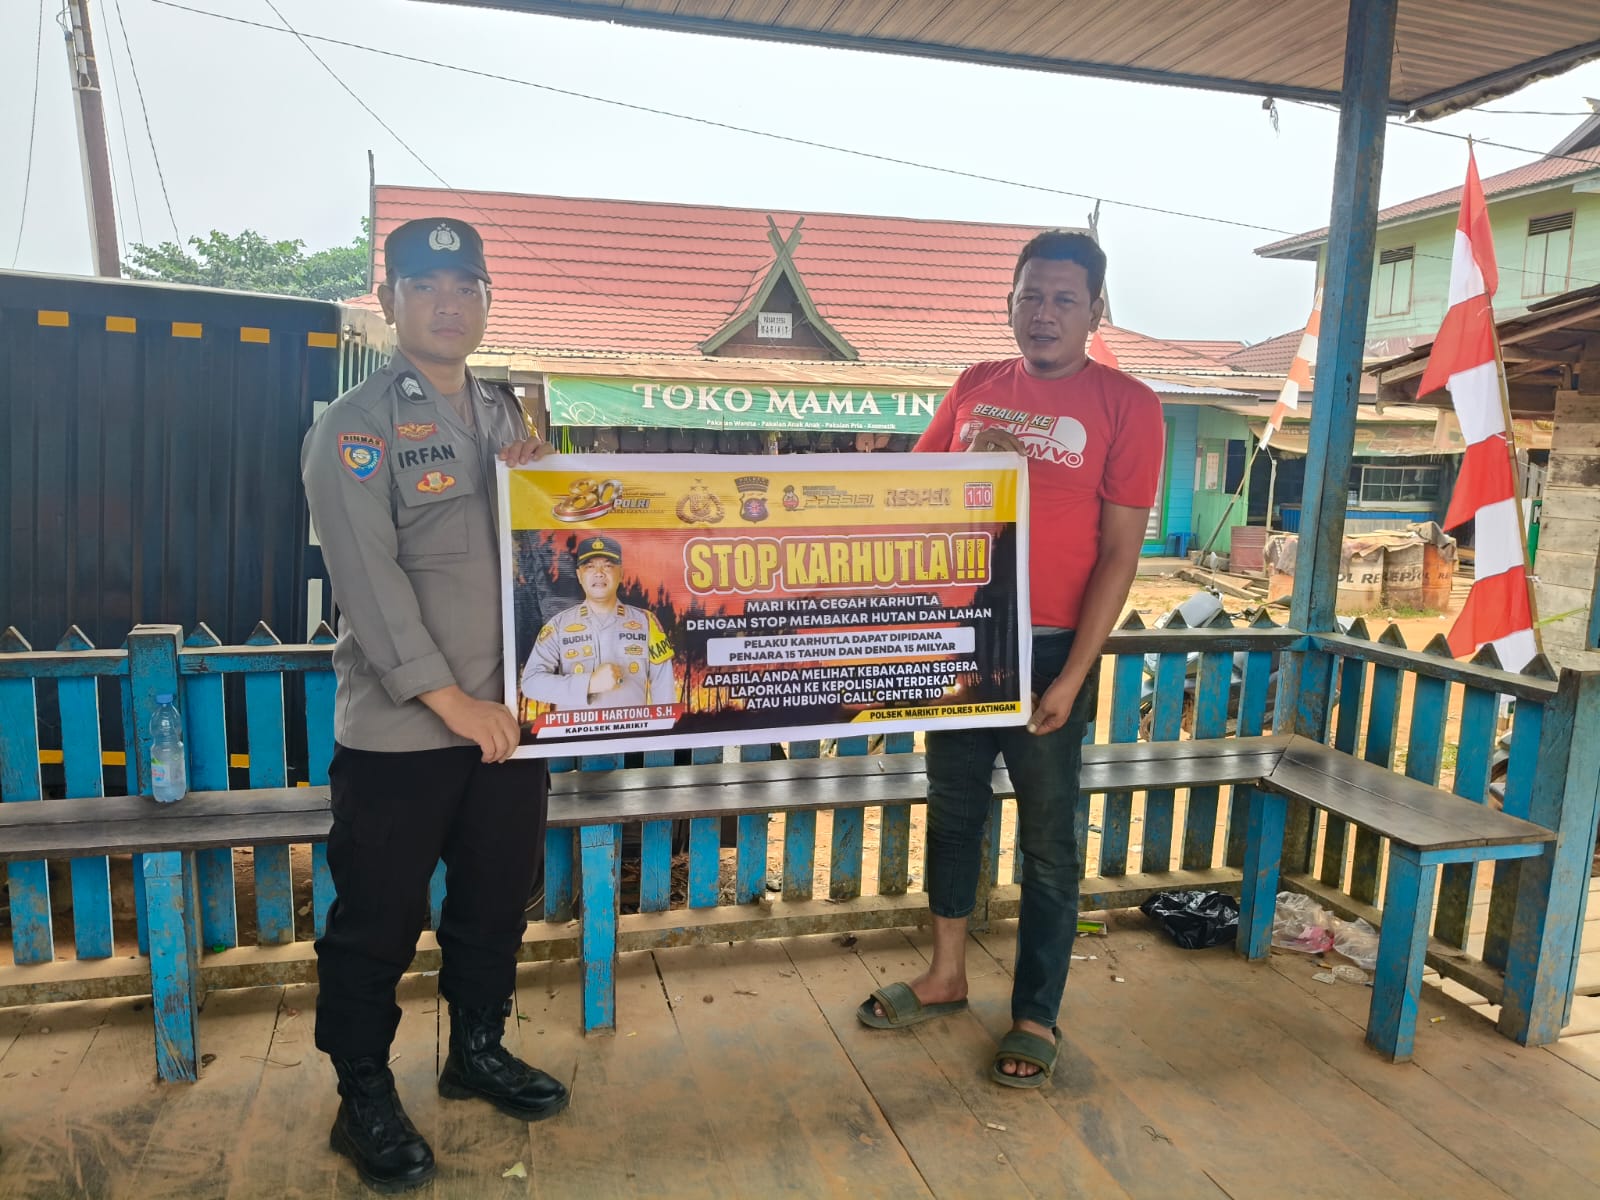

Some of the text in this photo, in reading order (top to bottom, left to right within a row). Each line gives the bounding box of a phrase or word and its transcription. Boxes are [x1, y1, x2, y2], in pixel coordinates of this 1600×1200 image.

[632, 382, 754, 413] TOKO
[763, 386, 882, 420] MAMA
[972, 403, 1054, 428] BERALIH KE
[343, 435, 380, 445] BINMAS
[398, 444, 456, 469] IRFAN
[613, 498, 651, 509] POLRI
[967, 489, 991, 505] 110
[689, 542, 778, 587] STOP
[785, 539, 950, 586] KARHUTLA
[747, 595, 940, 613] MARI KITA CEGAH KARHUTLA
[686, 608, 992, 631] DENGAN STOP MEMBAKAR HUTAN DAN LAHAN
[618, 632, 647, 641] POLRI
[744, 631, 943, 649] PELAKU KARHUTLA DAPAT DIPIDANA
[729, 642, 956, 662] PENJARA 15 TAHUN DAN DENDA 15 MILYAR
[704, 661, 978, 687] APABILA ANDA MELIHAT KEBAKARAN SEGERA
[731, 674, 956, 698] LAPORKAN KE KEPOLISIAN TERDEKAT
[746, 687, 942, 710] ATAU HUBUNGI CALL CENTER 110
[545, 706, 676, 725] IPTU BUDI HARTONO, S.H.
[870, 703, 1016, 720] POLSEK MARIKIT POLRES KATINGAN
[565, 721, 649, 734] KAPOLSEK MARIKIT
